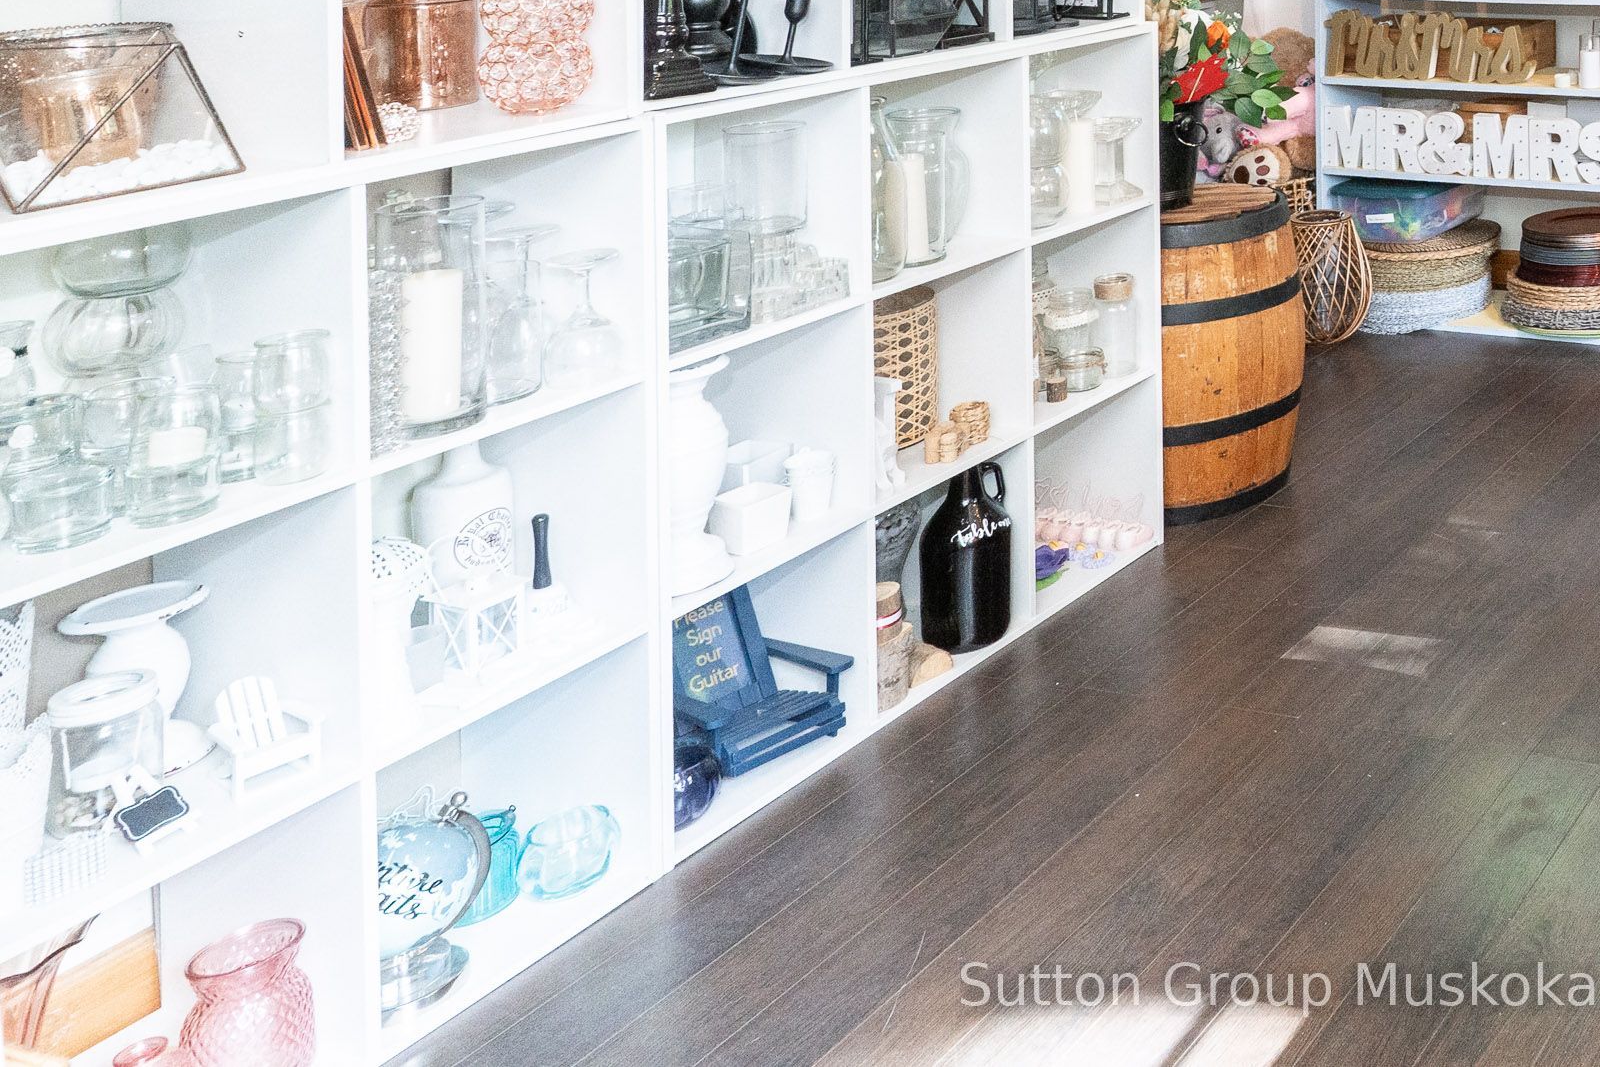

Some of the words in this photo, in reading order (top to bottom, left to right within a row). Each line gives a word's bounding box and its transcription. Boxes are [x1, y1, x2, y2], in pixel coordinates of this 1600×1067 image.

[951, 516, 997, 548] table
[687, 625, 722, 646] Sign
[696, 647, 722, 666] our
[689, 664, 739, 693] Guitar
